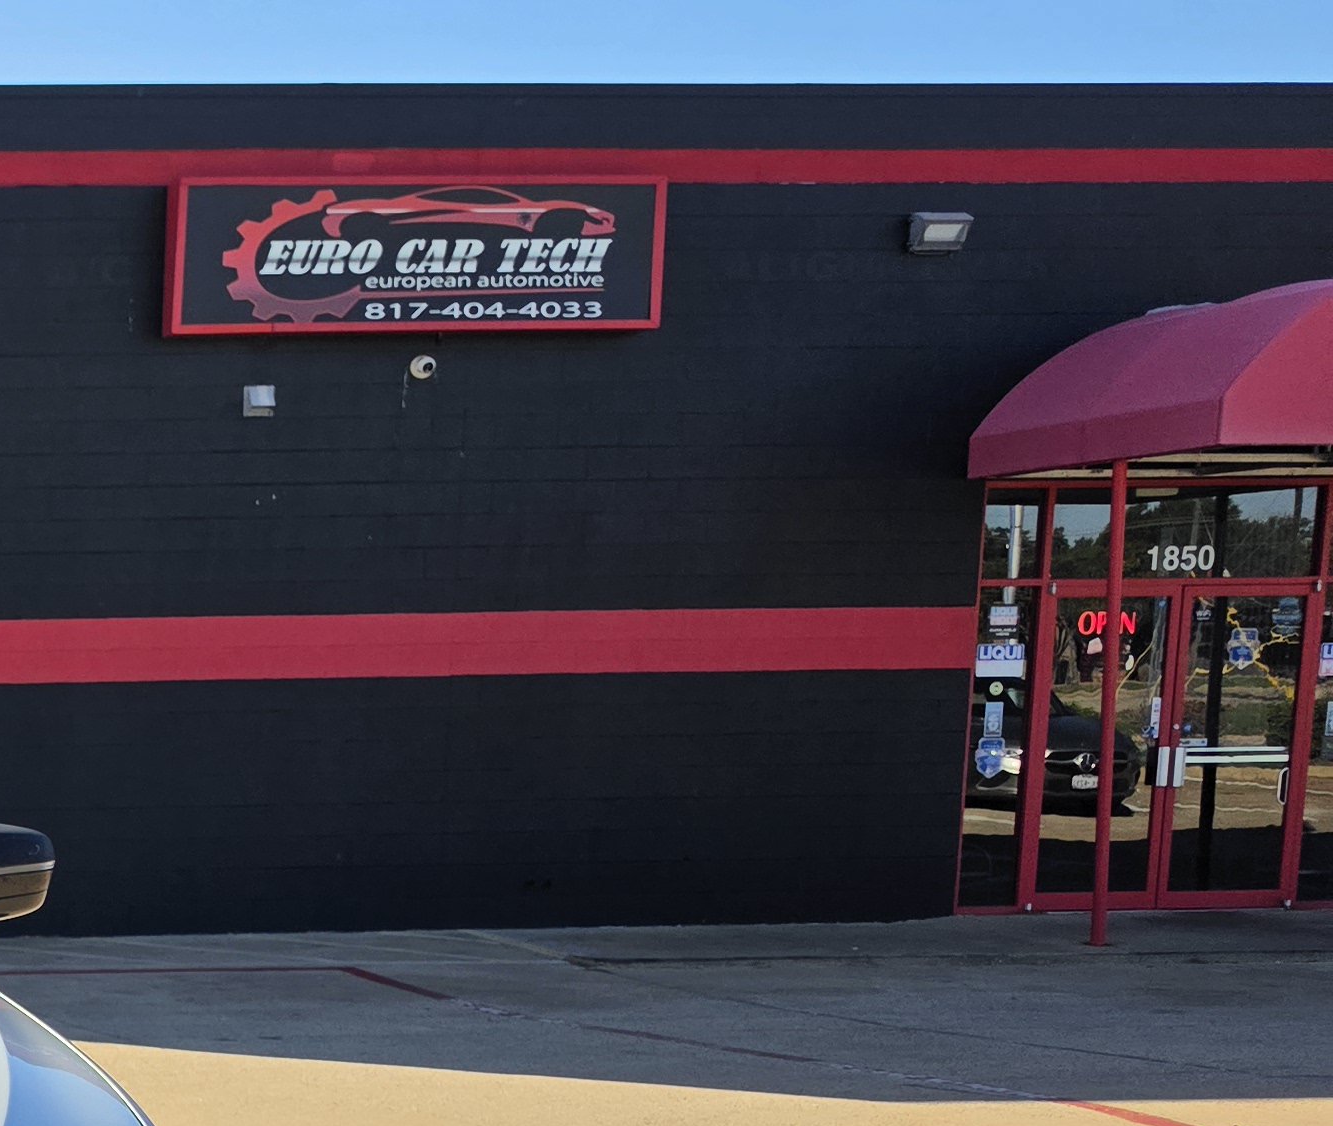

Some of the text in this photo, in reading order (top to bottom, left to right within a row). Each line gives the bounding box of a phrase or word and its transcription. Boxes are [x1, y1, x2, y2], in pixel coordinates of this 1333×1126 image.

[259, 237, 613, 275] EURO CAR TECH
[364, 271, 605, 292] european automotive
[364, 301, 603, 320] 817-404-4033
[1147, 544, 1215, 572] 1850
[1078, 611, 1137, 636] OPN
